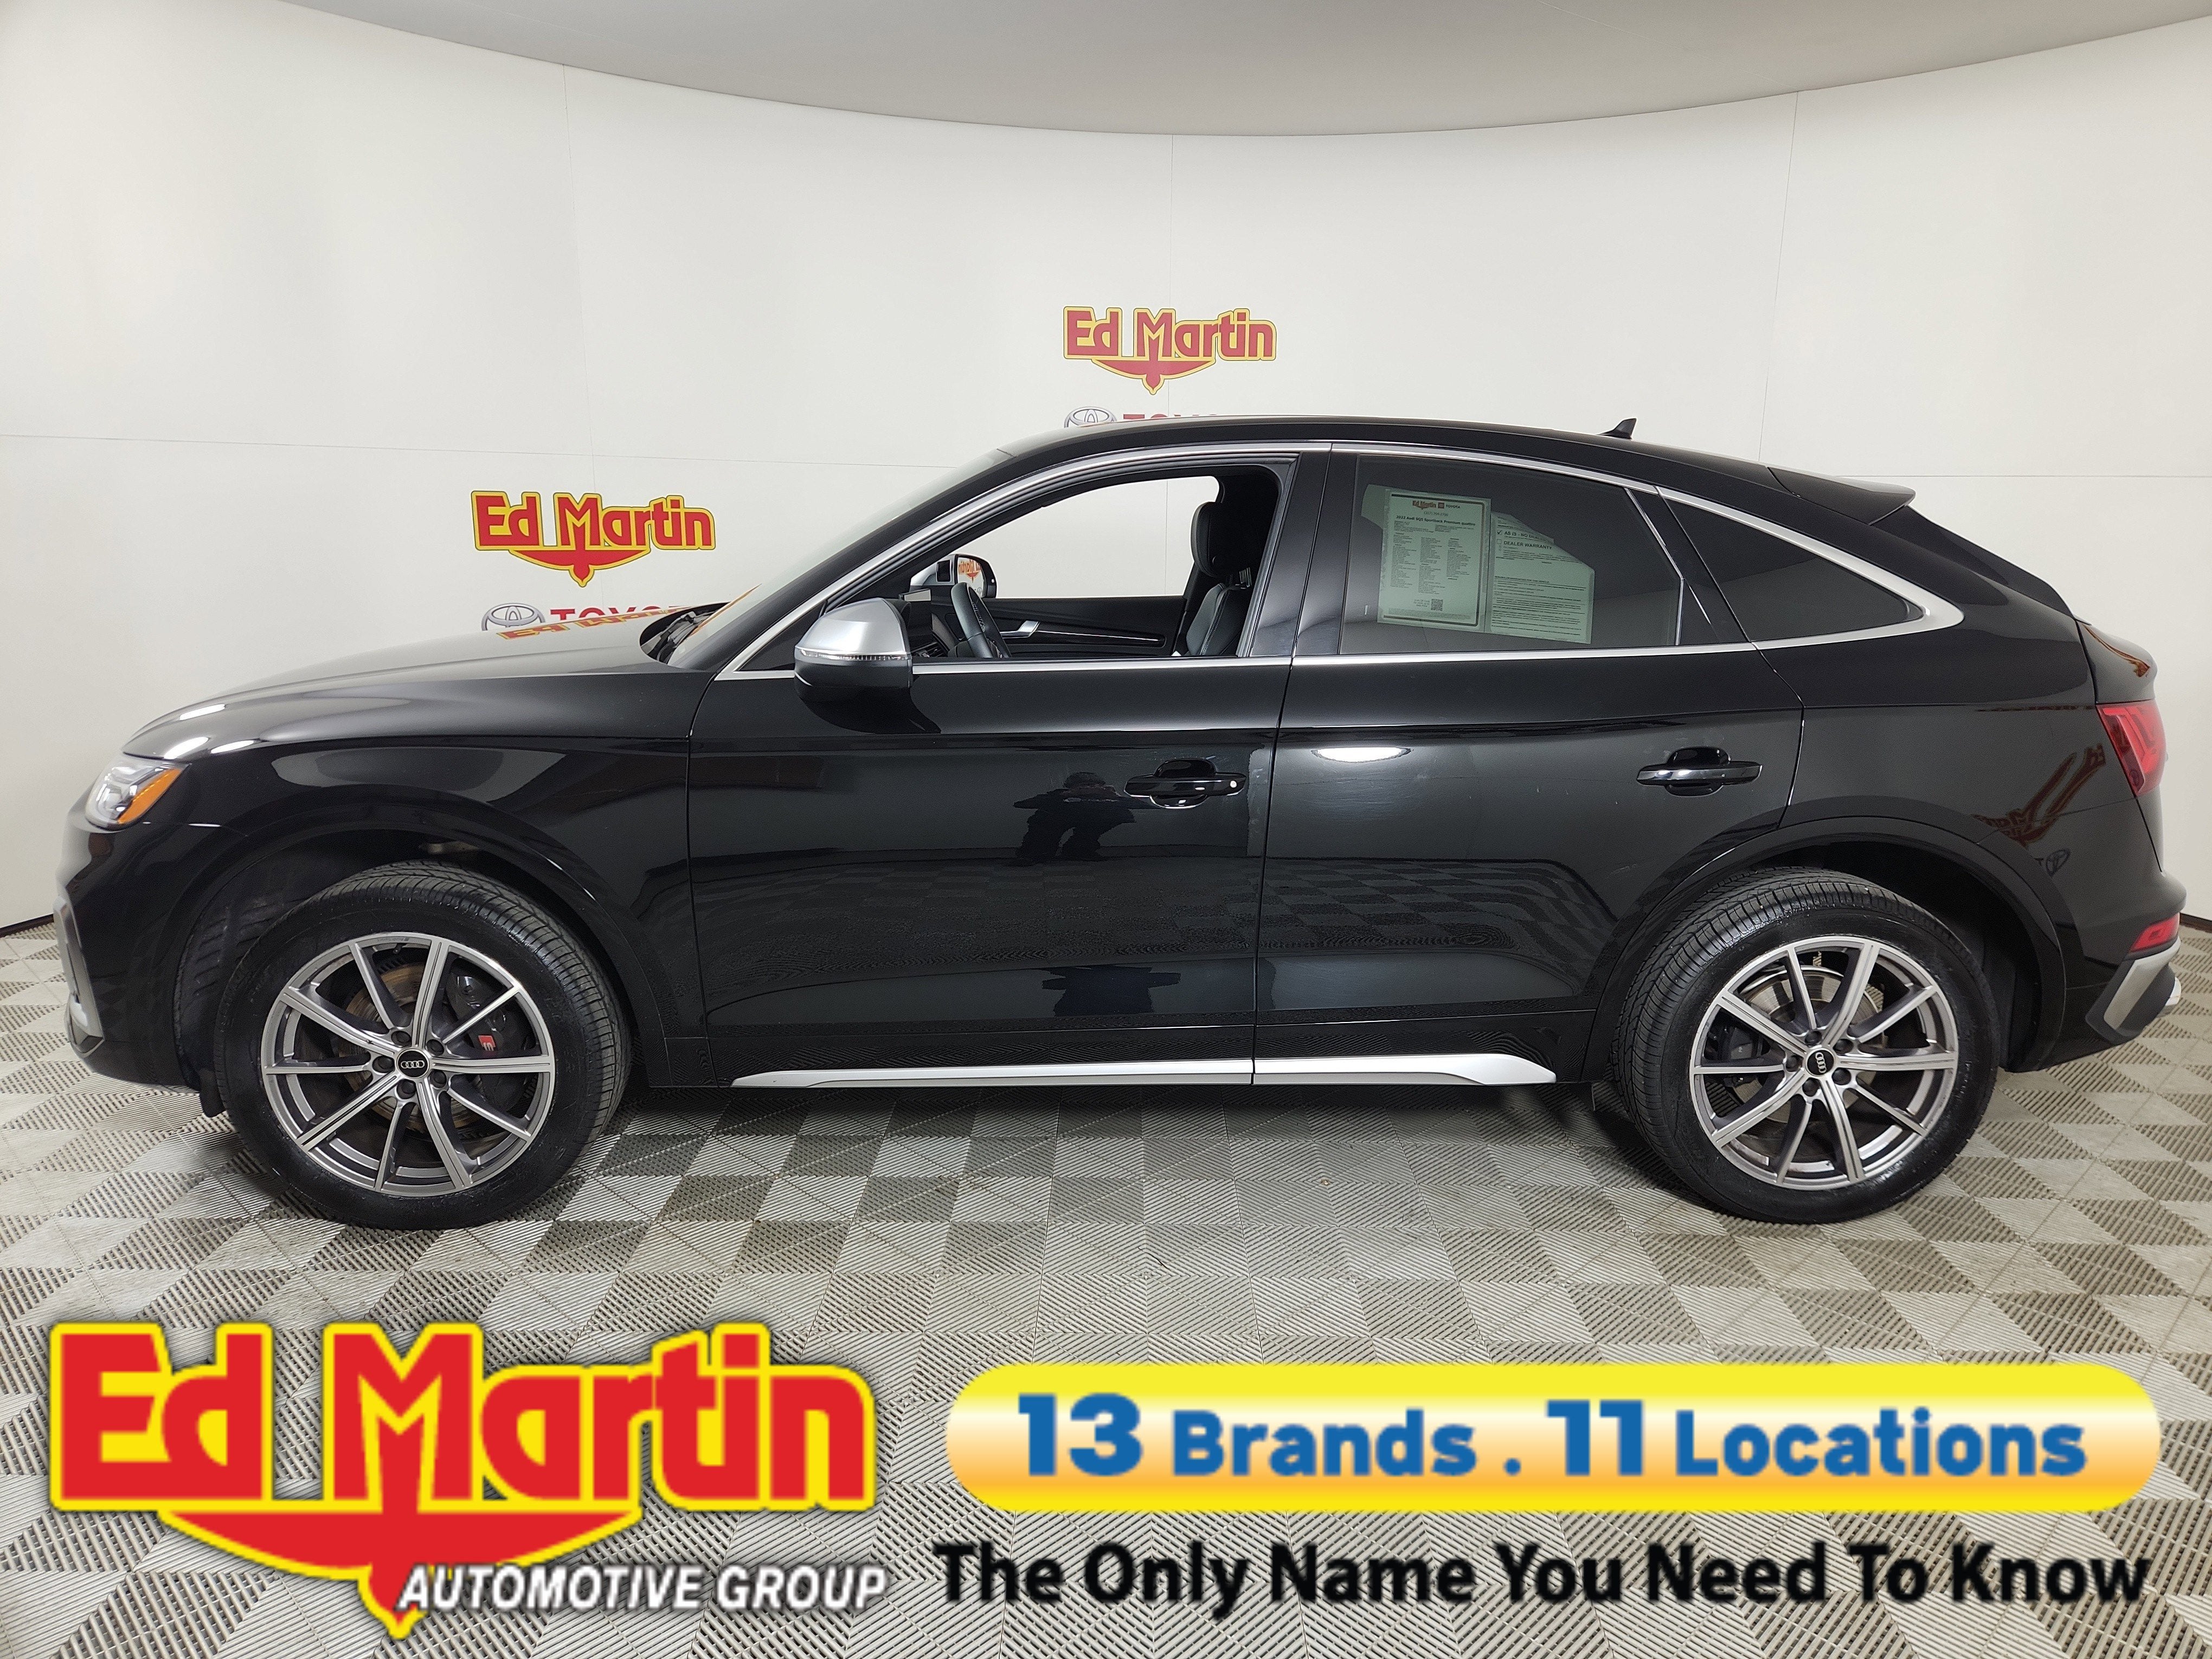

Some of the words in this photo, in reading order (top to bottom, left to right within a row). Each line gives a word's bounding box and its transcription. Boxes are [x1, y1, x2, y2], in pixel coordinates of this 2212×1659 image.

[1064, 307, 1122, 358] Ed
[1134, 308, 1276, 361] Martin
[472, 491, 543, 550] Ed
[554, 493, 715, 550] Martin
